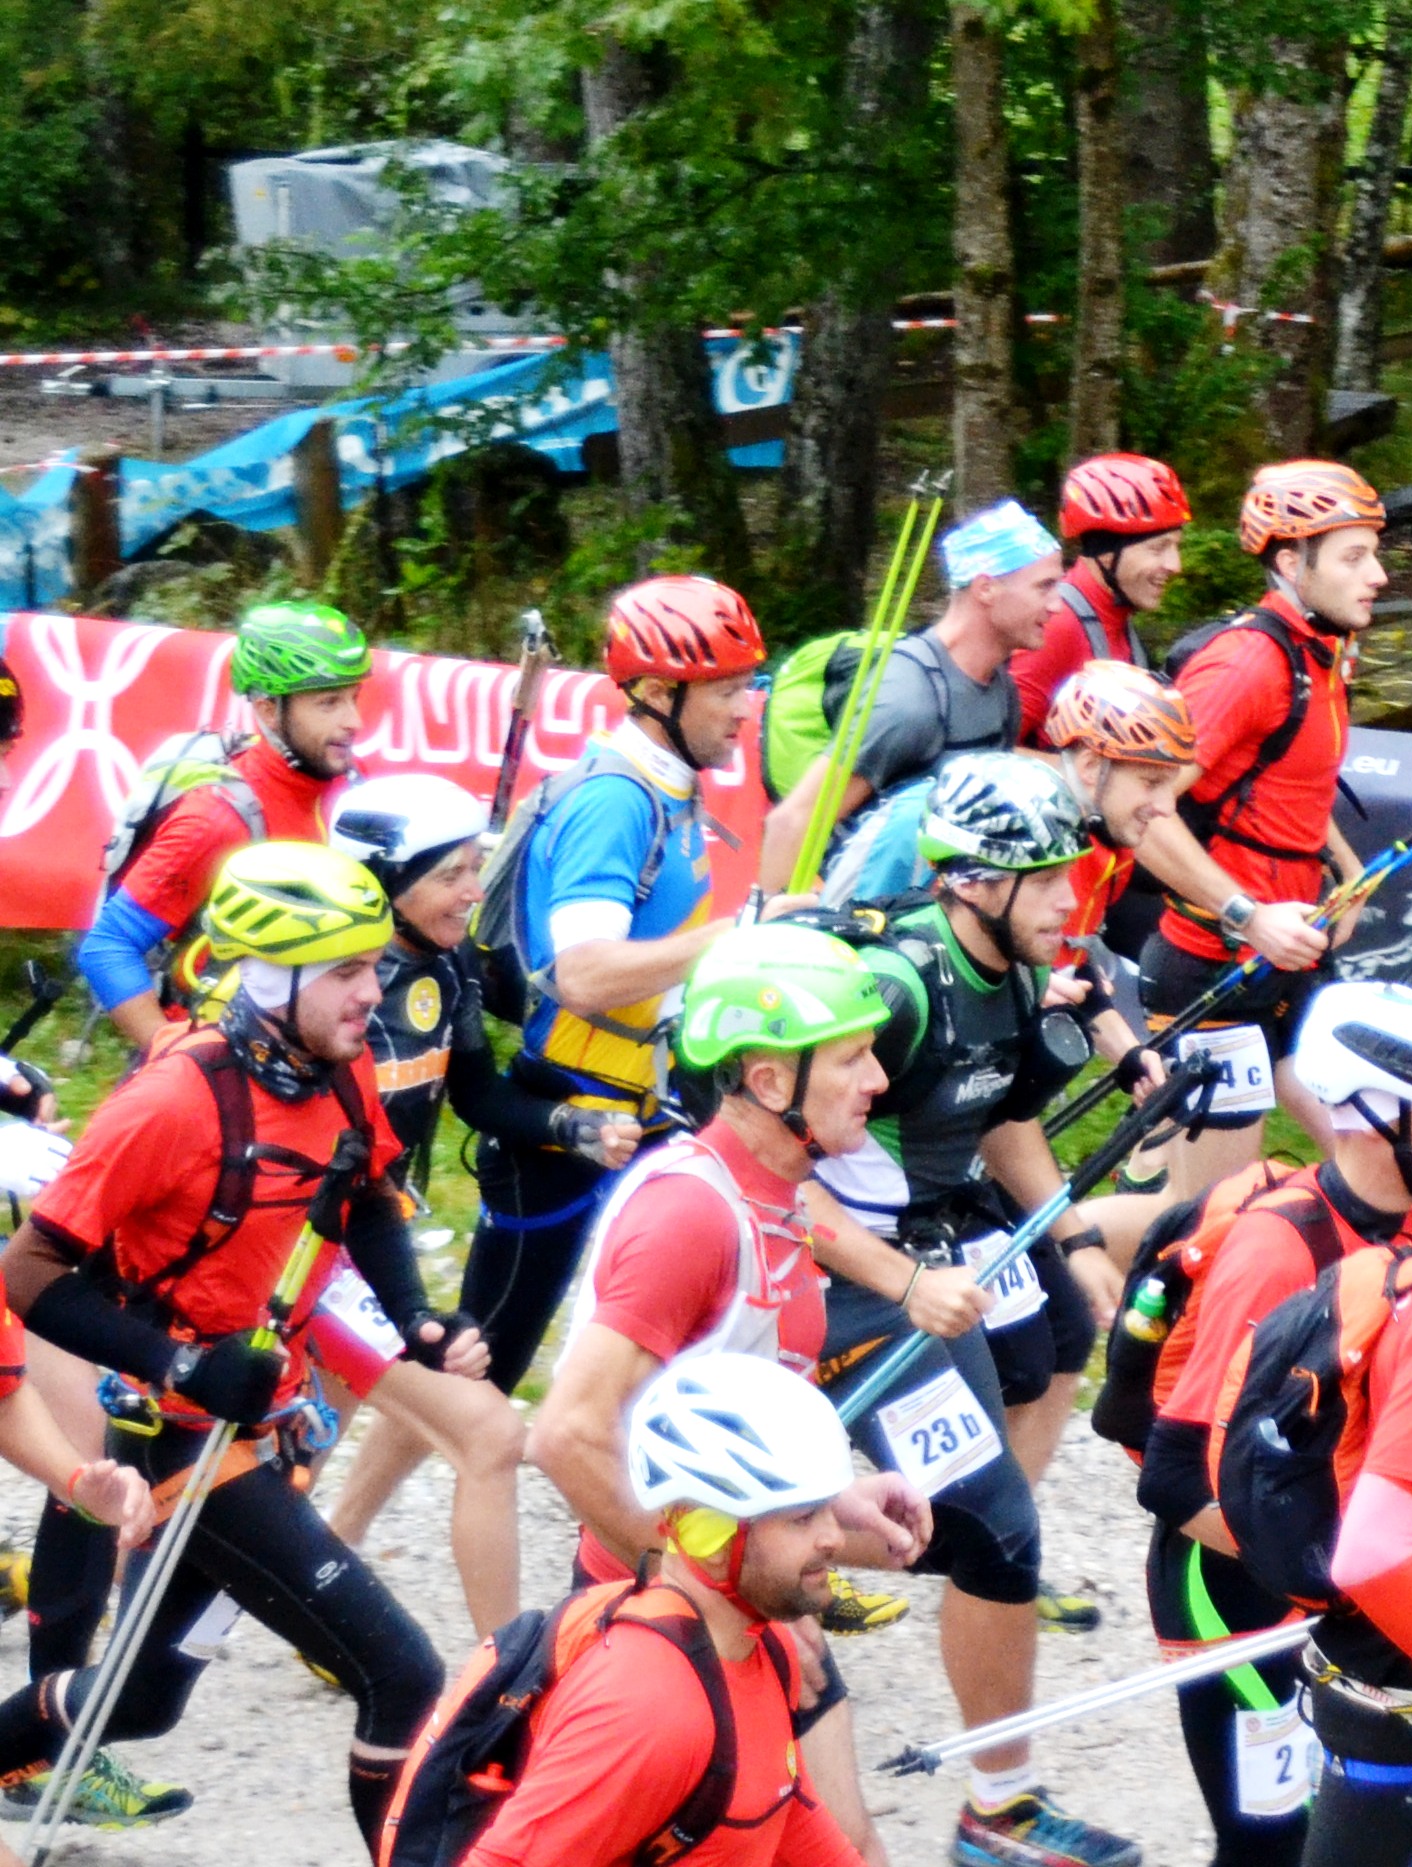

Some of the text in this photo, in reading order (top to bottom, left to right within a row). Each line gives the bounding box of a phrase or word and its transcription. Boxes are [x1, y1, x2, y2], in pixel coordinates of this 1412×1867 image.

[911, 1412, 982, 1466] 23 b
[1275, 1744, 1293, 1785] 2
